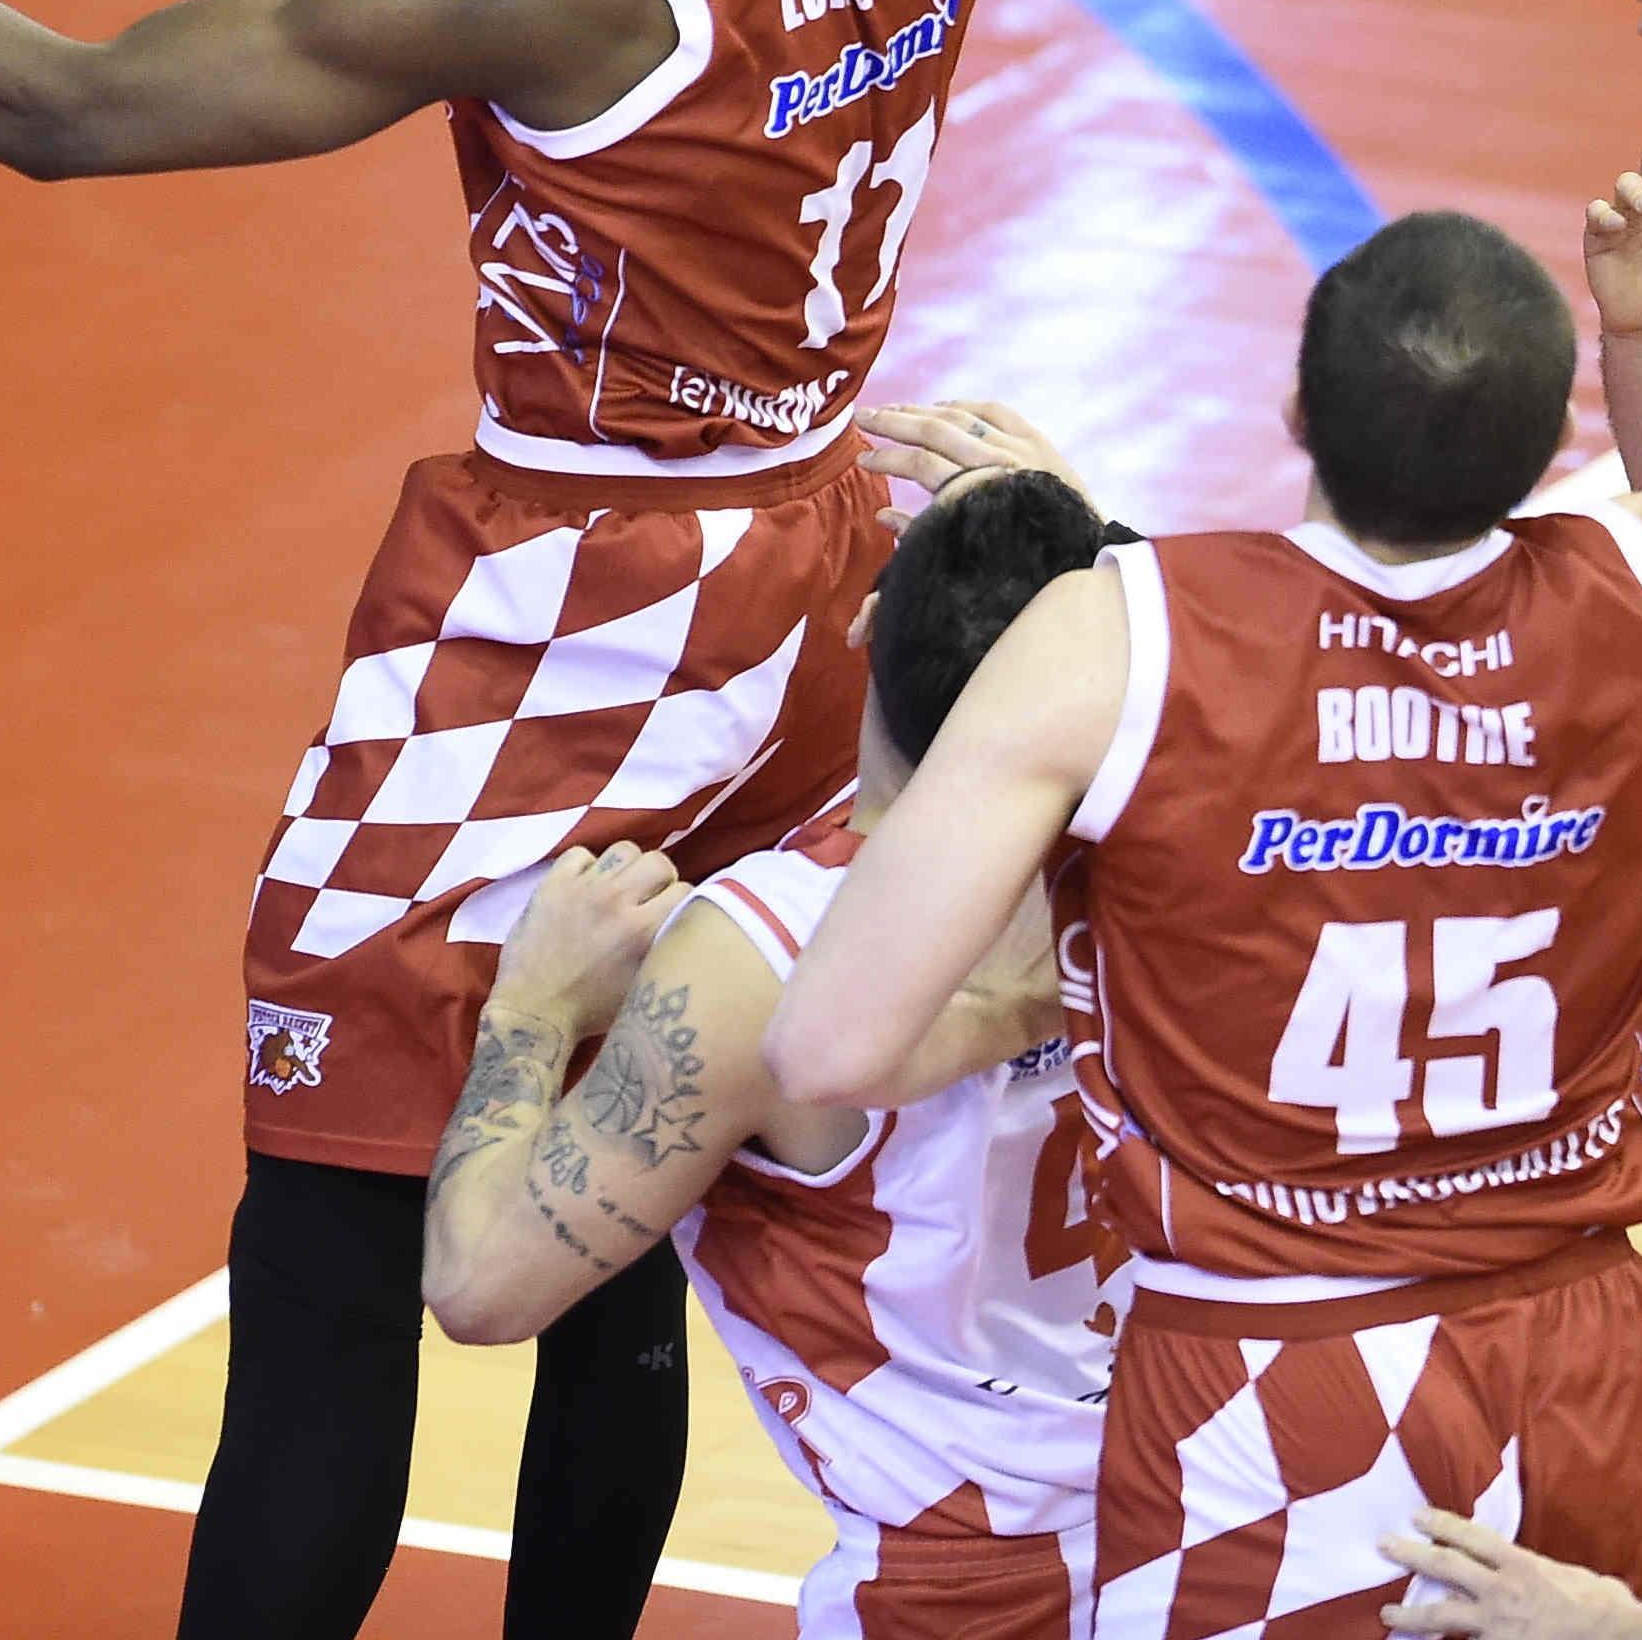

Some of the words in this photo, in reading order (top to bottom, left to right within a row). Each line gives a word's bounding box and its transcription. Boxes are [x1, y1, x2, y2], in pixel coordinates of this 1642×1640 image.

[797, 96, 936, 350] 11
[1316, 684, 1537, 768] BOOTHE
[1238, 794, 1607, 874] PerDormire
[1267, 906, 1561, 1155] 45
